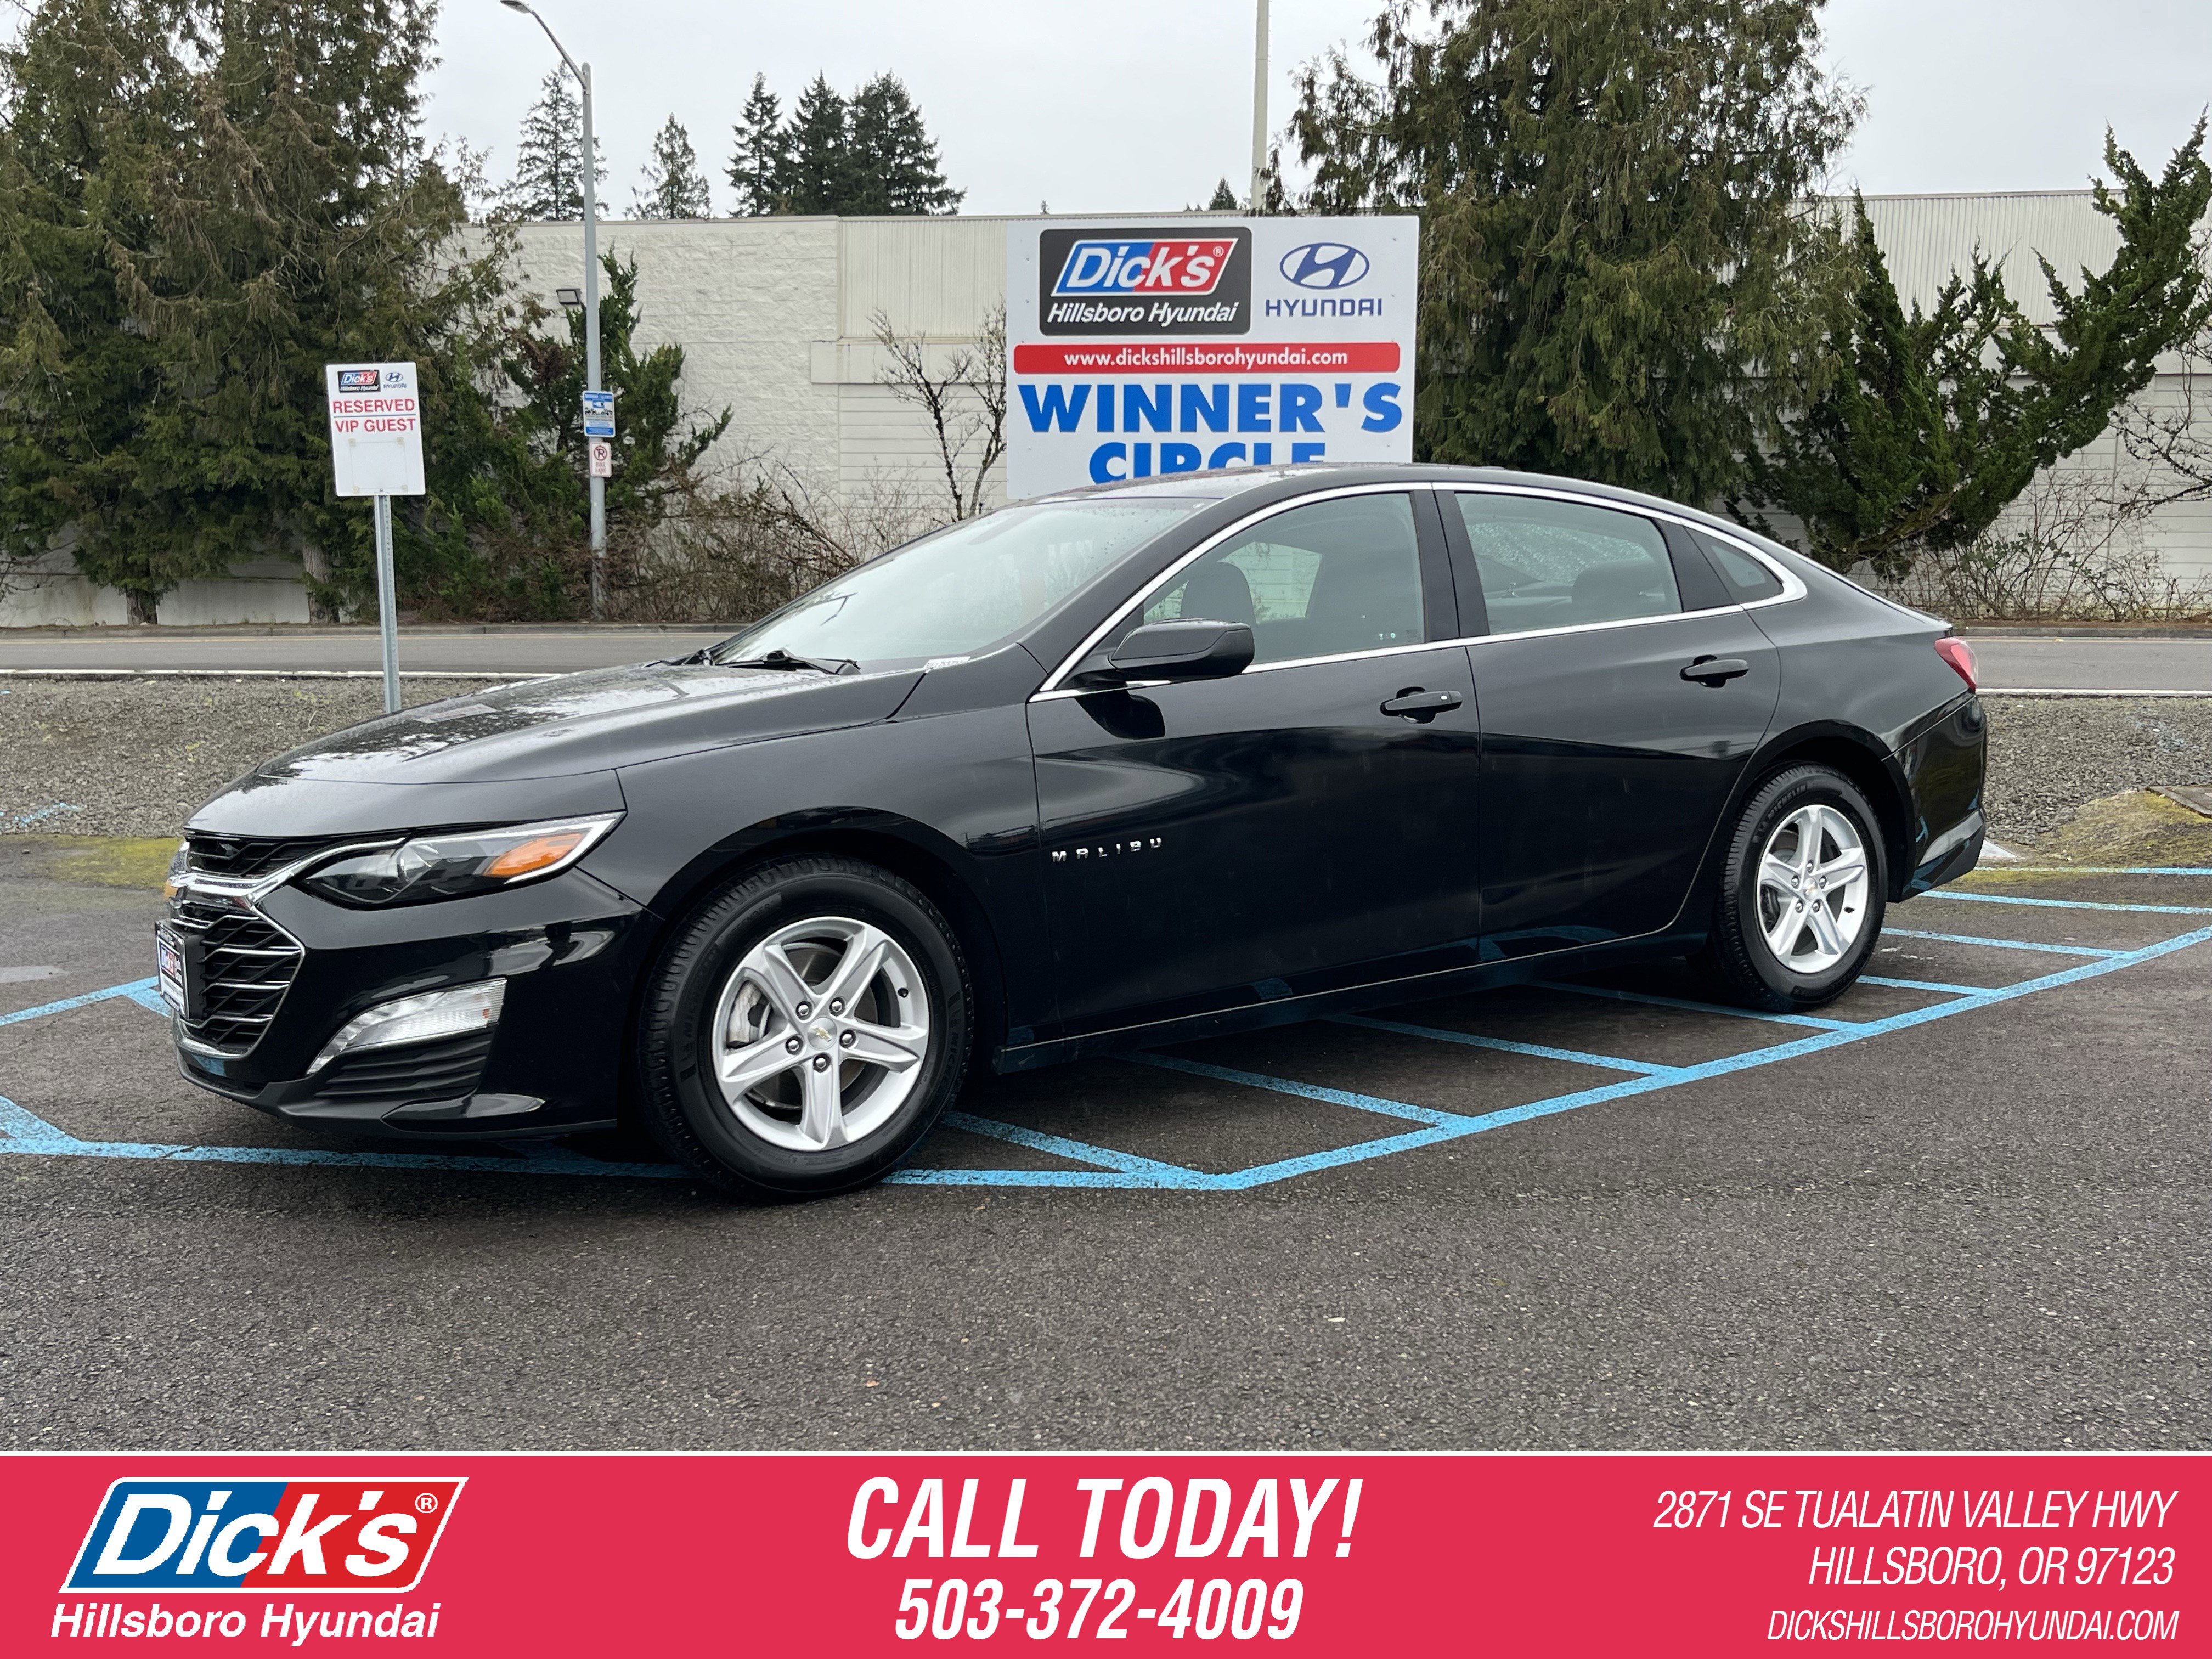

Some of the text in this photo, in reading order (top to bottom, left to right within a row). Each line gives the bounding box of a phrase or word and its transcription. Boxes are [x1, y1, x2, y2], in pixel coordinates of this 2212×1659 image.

[1047, 302, 1239, 328] Hillsboro Hyundai
[1265, 298, 1383, 317] HYUNDAI
[1064, 347, 1348, 370] www.dickshillsborohyundai.com
[332, 398, 415, 414] RESERVED
[1017, 381, 1402, 433] WINNER'S
[335, 418, 416, 433] VIP GUEST
[1052, 837, 1161, 862] MALIBU
